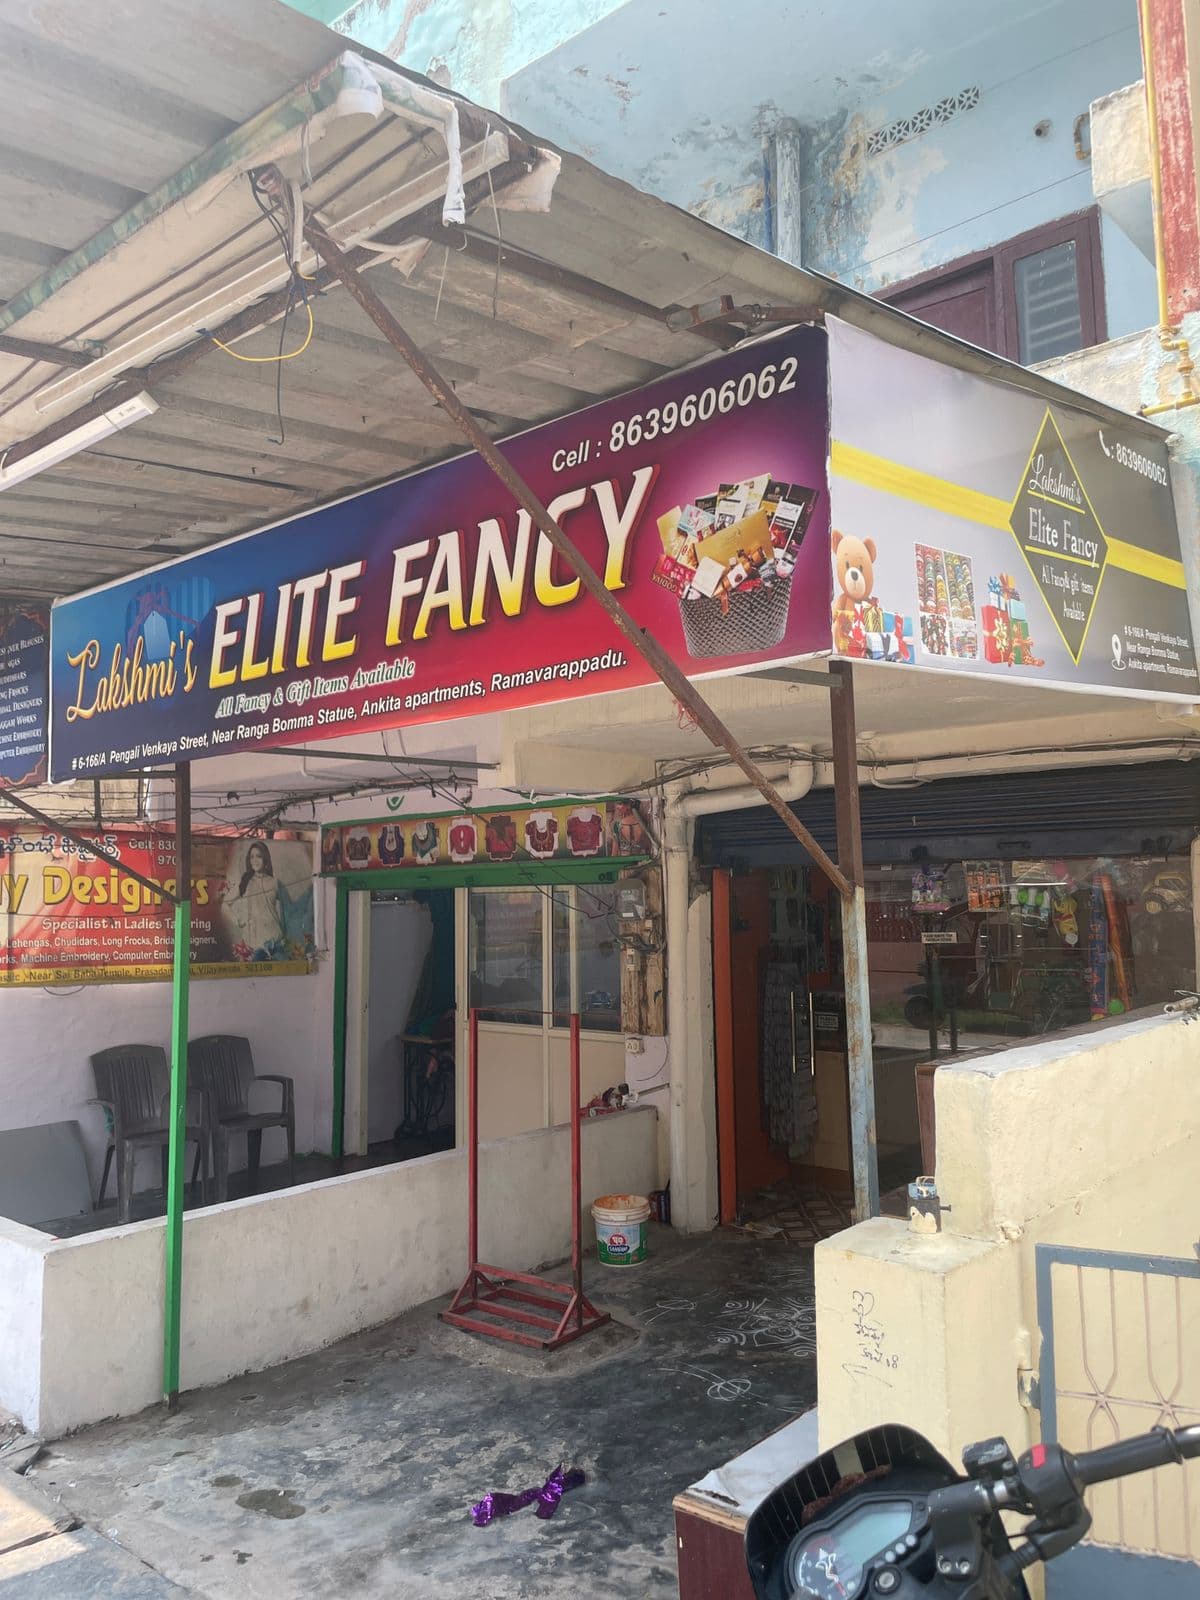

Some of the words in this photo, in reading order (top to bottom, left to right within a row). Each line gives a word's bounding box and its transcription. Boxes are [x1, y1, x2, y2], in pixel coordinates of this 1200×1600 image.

[551, 442, 589, 473] Cell
[609, 357, 798, 452] 8639606062
[1029, 453, 1082, 505] Lakshmi's
[1029, 507, 1058, 547] Elite
[1063, 519, 1099, 567] Fancy
[66, 630, 197, 723] Lakshmi's
[208, 560, 366, 689] ELITE
[385, 464, 660, 647] FANCY
[109, 747, 140, 765] Pengali
[141, 741, 178, 760] Venkaya
[179, 732, 209, 751] Street,
[212, 728, 234, 745] Near
[237, 722, 269, 740] Ranga
[272, 713, 314, 733] Bomma
[317, 704, 357, 726] Statue,
[361, 695, 401, 715] Ankita
[404, 680, 486, 711] apartments,
[490, 648, 628, 691] Ramavarappadu.
[214, 696, 234, 719] All
[234, 691, 271, 715] Fancy
[272, 687, 284, 706] &
[286, 679, 312, 705] Gift
[313, 673, 349, 698] Items
[351, 656, 415, 691] Available
[43, 866, 208, 914] Designs
[42, 917, 107, 934] Specialist
[124, 917, 163, 930] Ladies
[165, 917, 212, 932] Taring
[102, 936, 122, 948] Long
[154, 936, 175, 946] Brida
[21, 953, 58, 964] Machine
[113, 949, 152, 961] Computer
